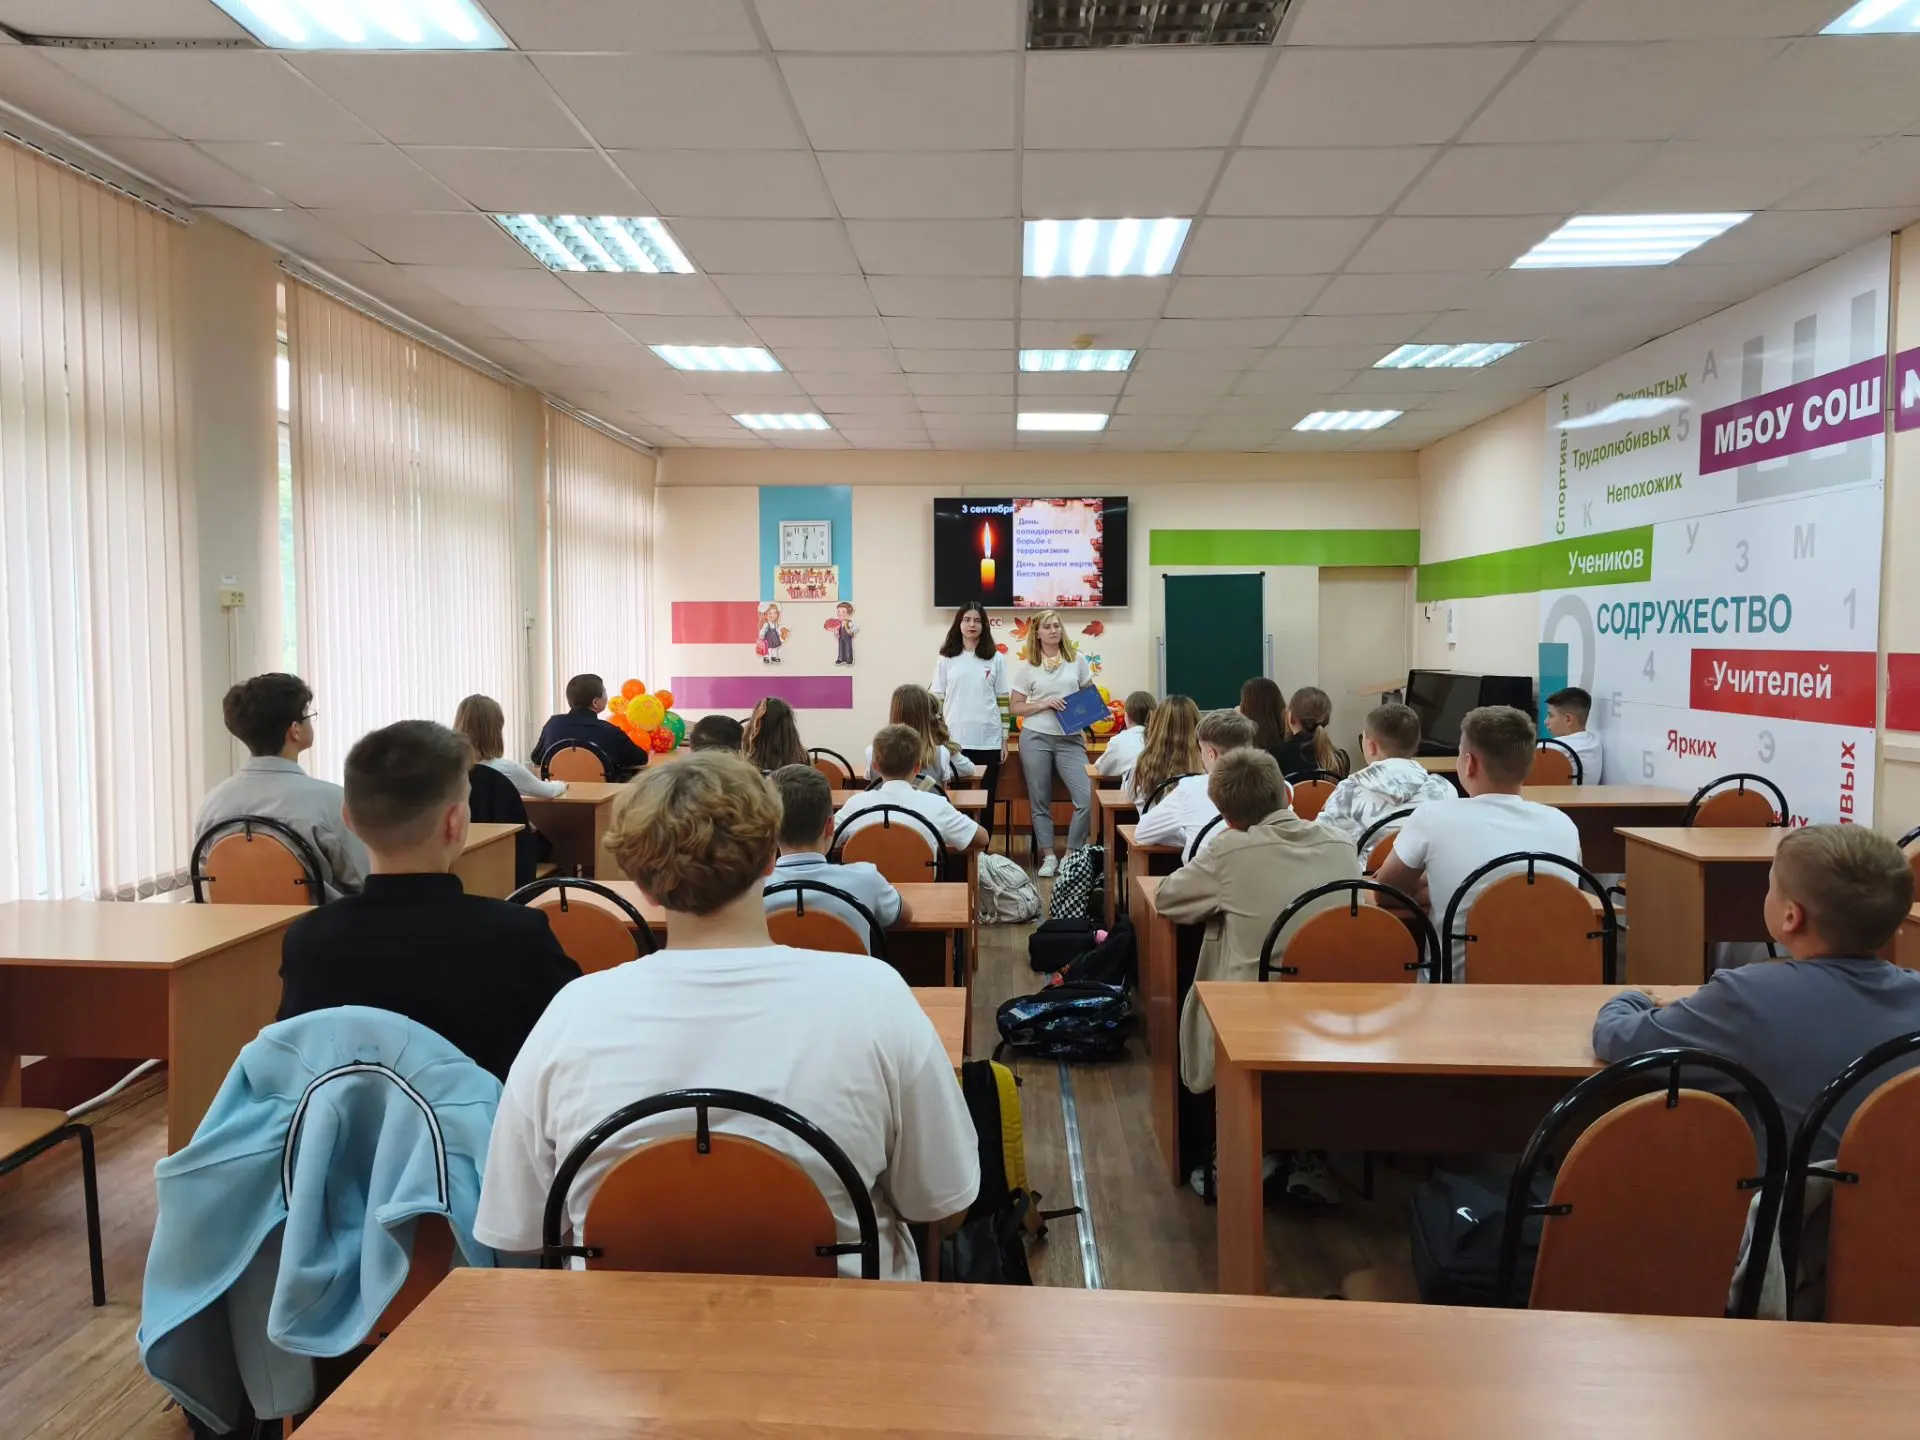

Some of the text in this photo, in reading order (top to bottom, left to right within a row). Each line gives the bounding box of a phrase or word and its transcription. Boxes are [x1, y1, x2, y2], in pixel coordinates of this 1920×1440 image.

[1677, 407, 1690, 441] 5
[1713, 402, 1794, 456] МБОУ
[1803, 376, 1881, 432] СОШ
[1573, 424, 1671, 471] Трудолюбивых
[1607, 472, 1683, 504] Непохожих
[962, 504, 968, 513] 3
[1568, 548, 1644, 576] Учеников
[1597, 593, 1792, 640] СОДРУЖЕСТВО
[1642, 650, 1656, 682] 4
[1712, 660, 1832, 699] Учителей
[1667, 729, 1717, 759] Ярких
[1758, 729, 1775, 763] Э
